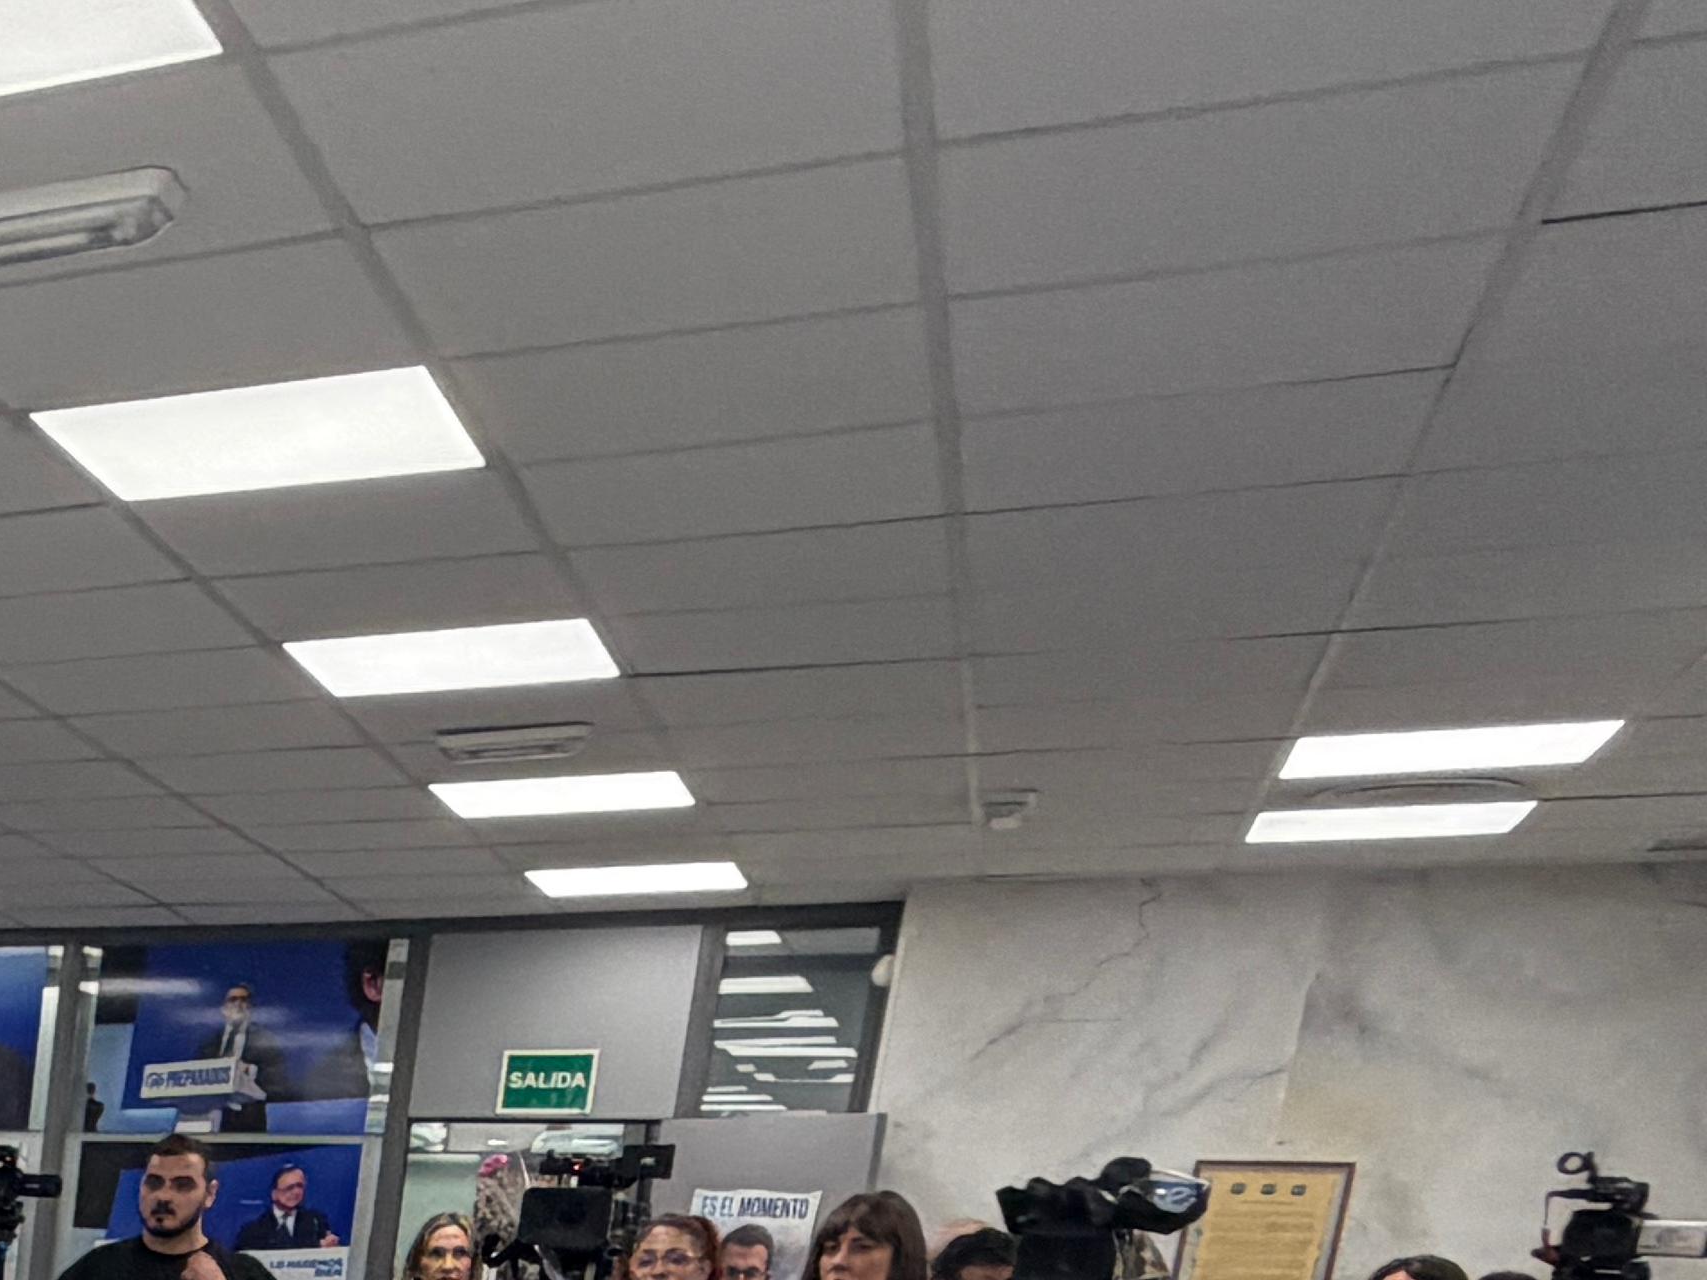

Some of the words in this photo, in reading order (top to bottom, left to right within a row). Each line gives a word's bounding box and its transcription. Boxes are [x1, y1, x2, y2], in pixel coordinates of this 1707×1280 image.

[509, 1071, 587, 1089] SALIDA
[701, 1196, 718, 1217] ES
[720, 1196, 734, 1217] EL
[737, 1196, 810, 1219] MOMENTO
